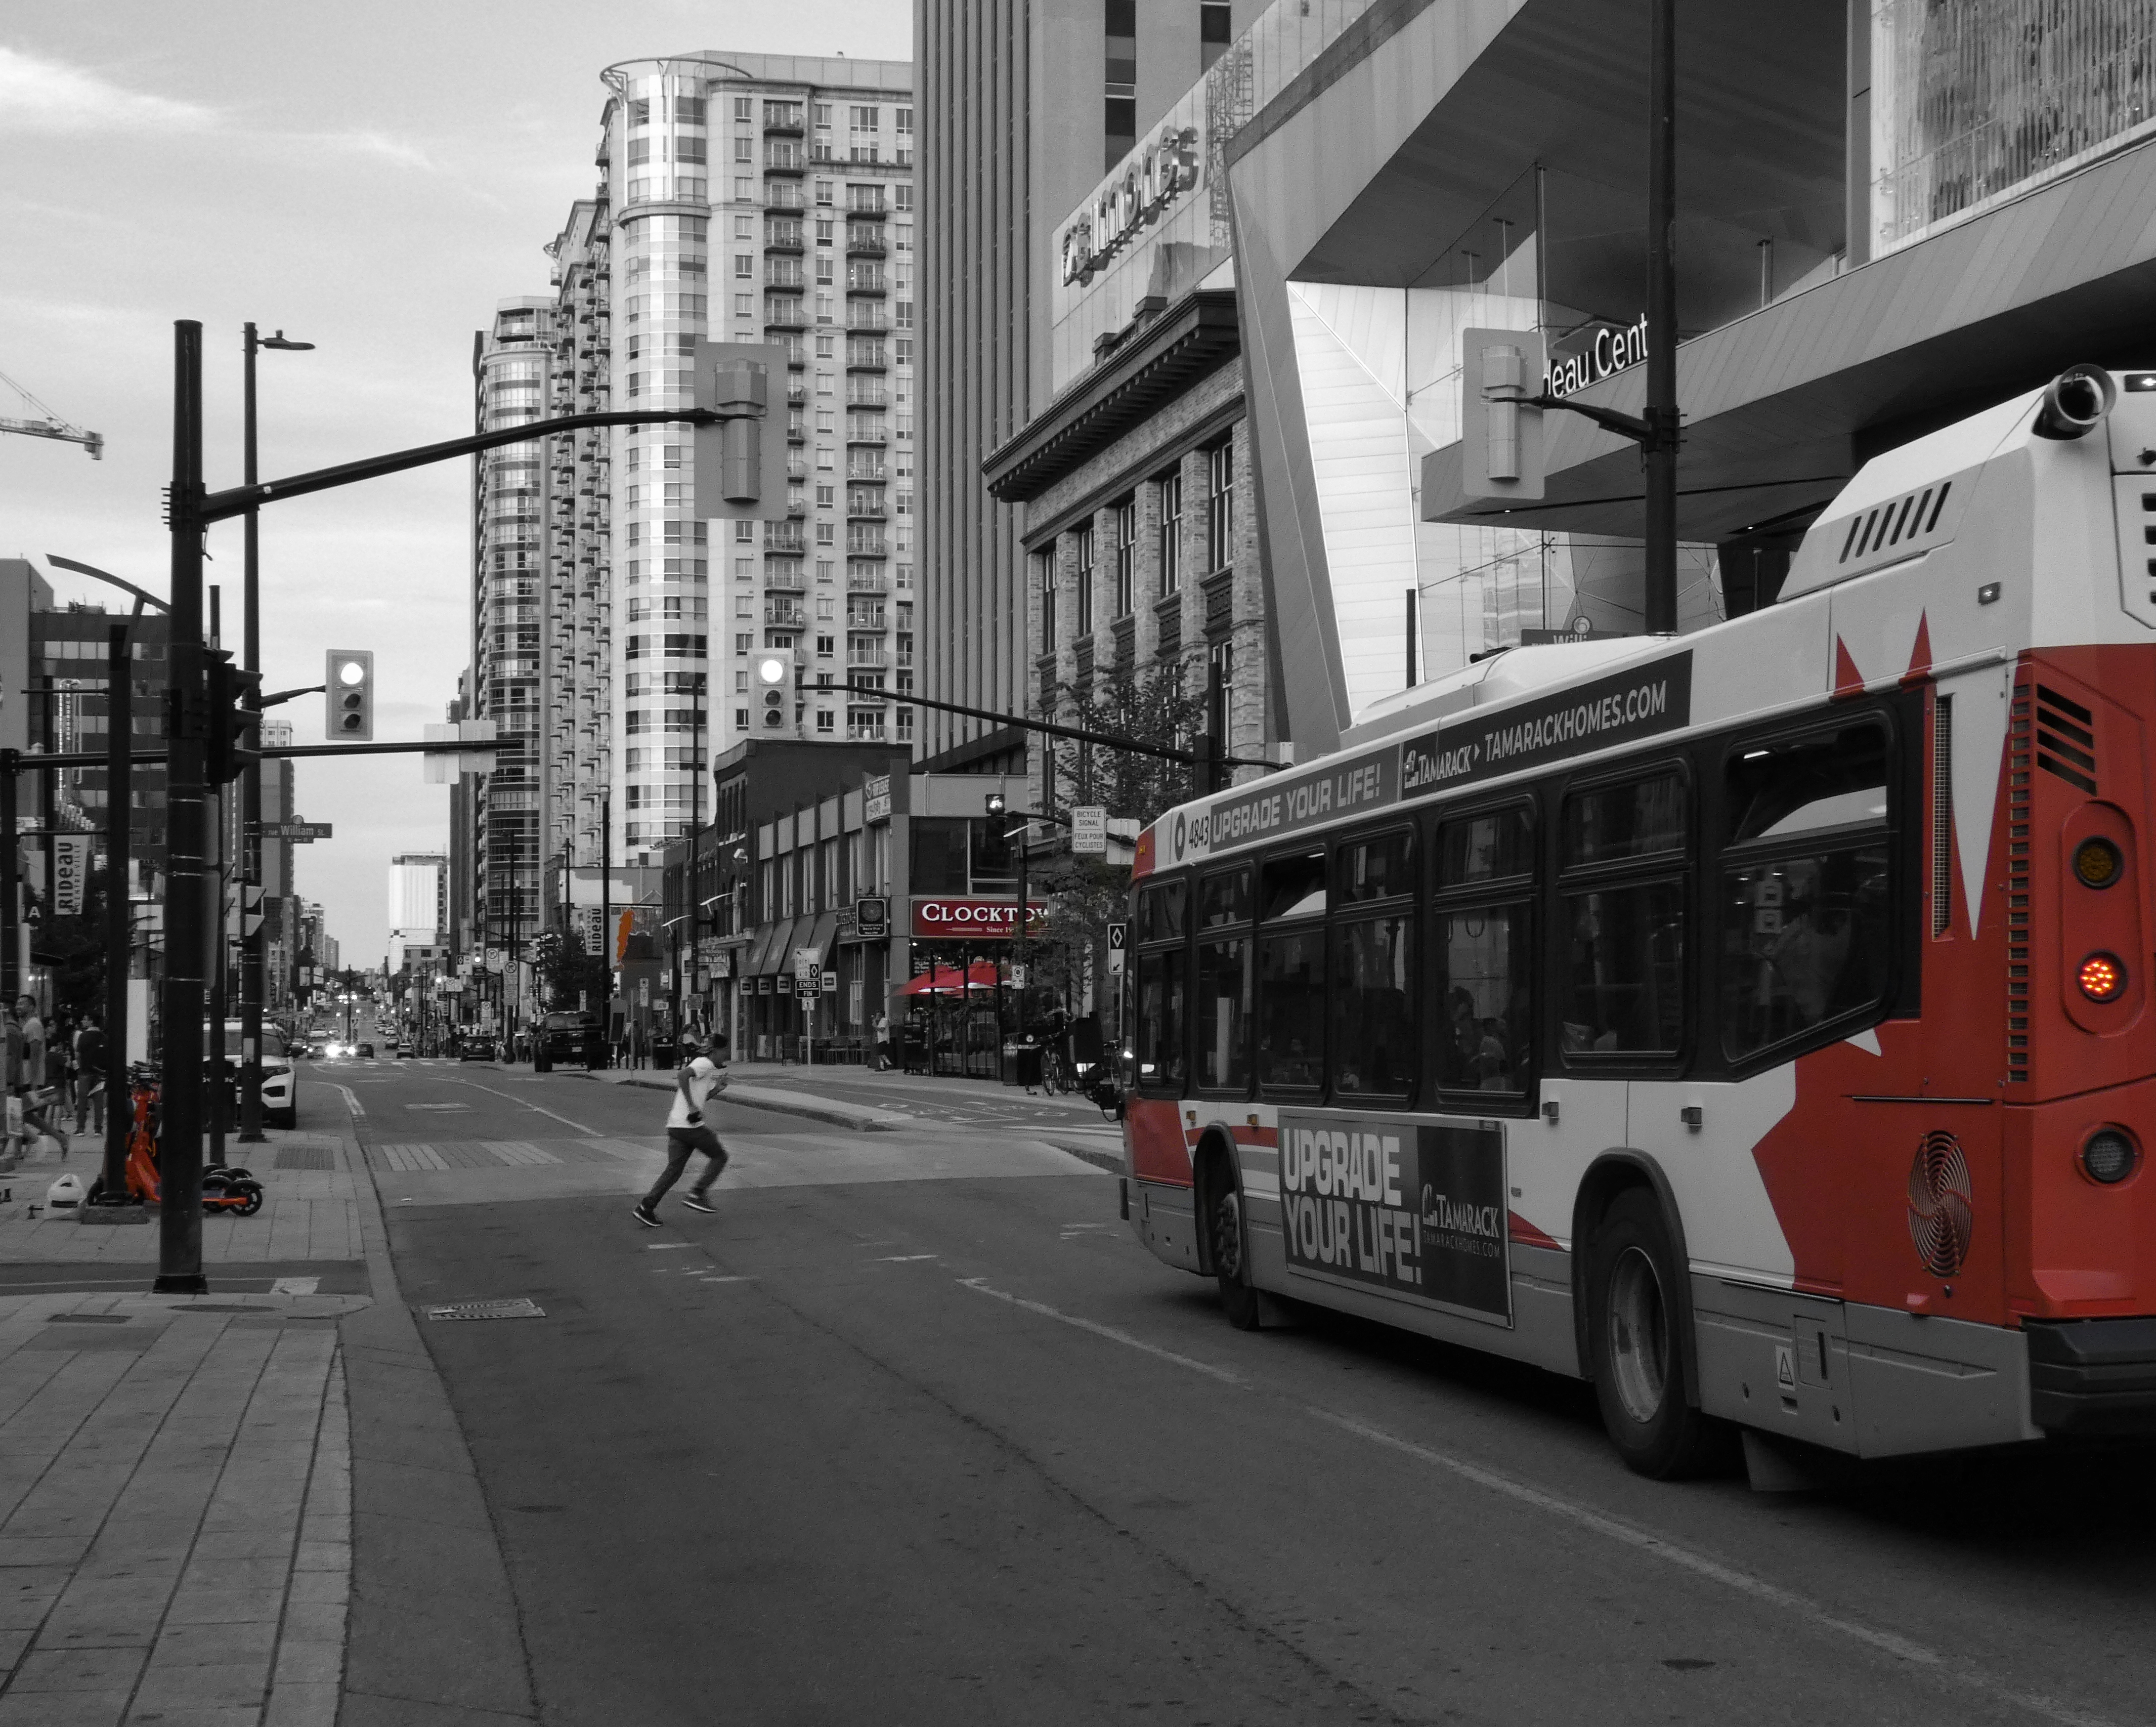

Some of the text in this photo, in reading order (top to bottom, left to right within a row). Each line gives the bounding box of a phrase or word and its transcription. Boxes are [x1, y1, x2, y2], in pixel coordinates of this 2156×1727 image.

[1543, 313, 1648, 398] deau Cent
[1554, 634, 1587, 644] Willi
[1418, 681, 1666, 785] TAMARACK TAMARACKHOMES.COM
[281, 825, 314, 835] William
[1189, 816, 1209, 849] 4843
[1214, 763, 1381, 843] UPGRADE YOUR LIFE!
[1283, 1128, 1402, 1206] UPGRADE
[1283, 1193, 1422, 1285] YOUR LIFE!
[1436, 1195, 1500, 1238] TAMARACK
